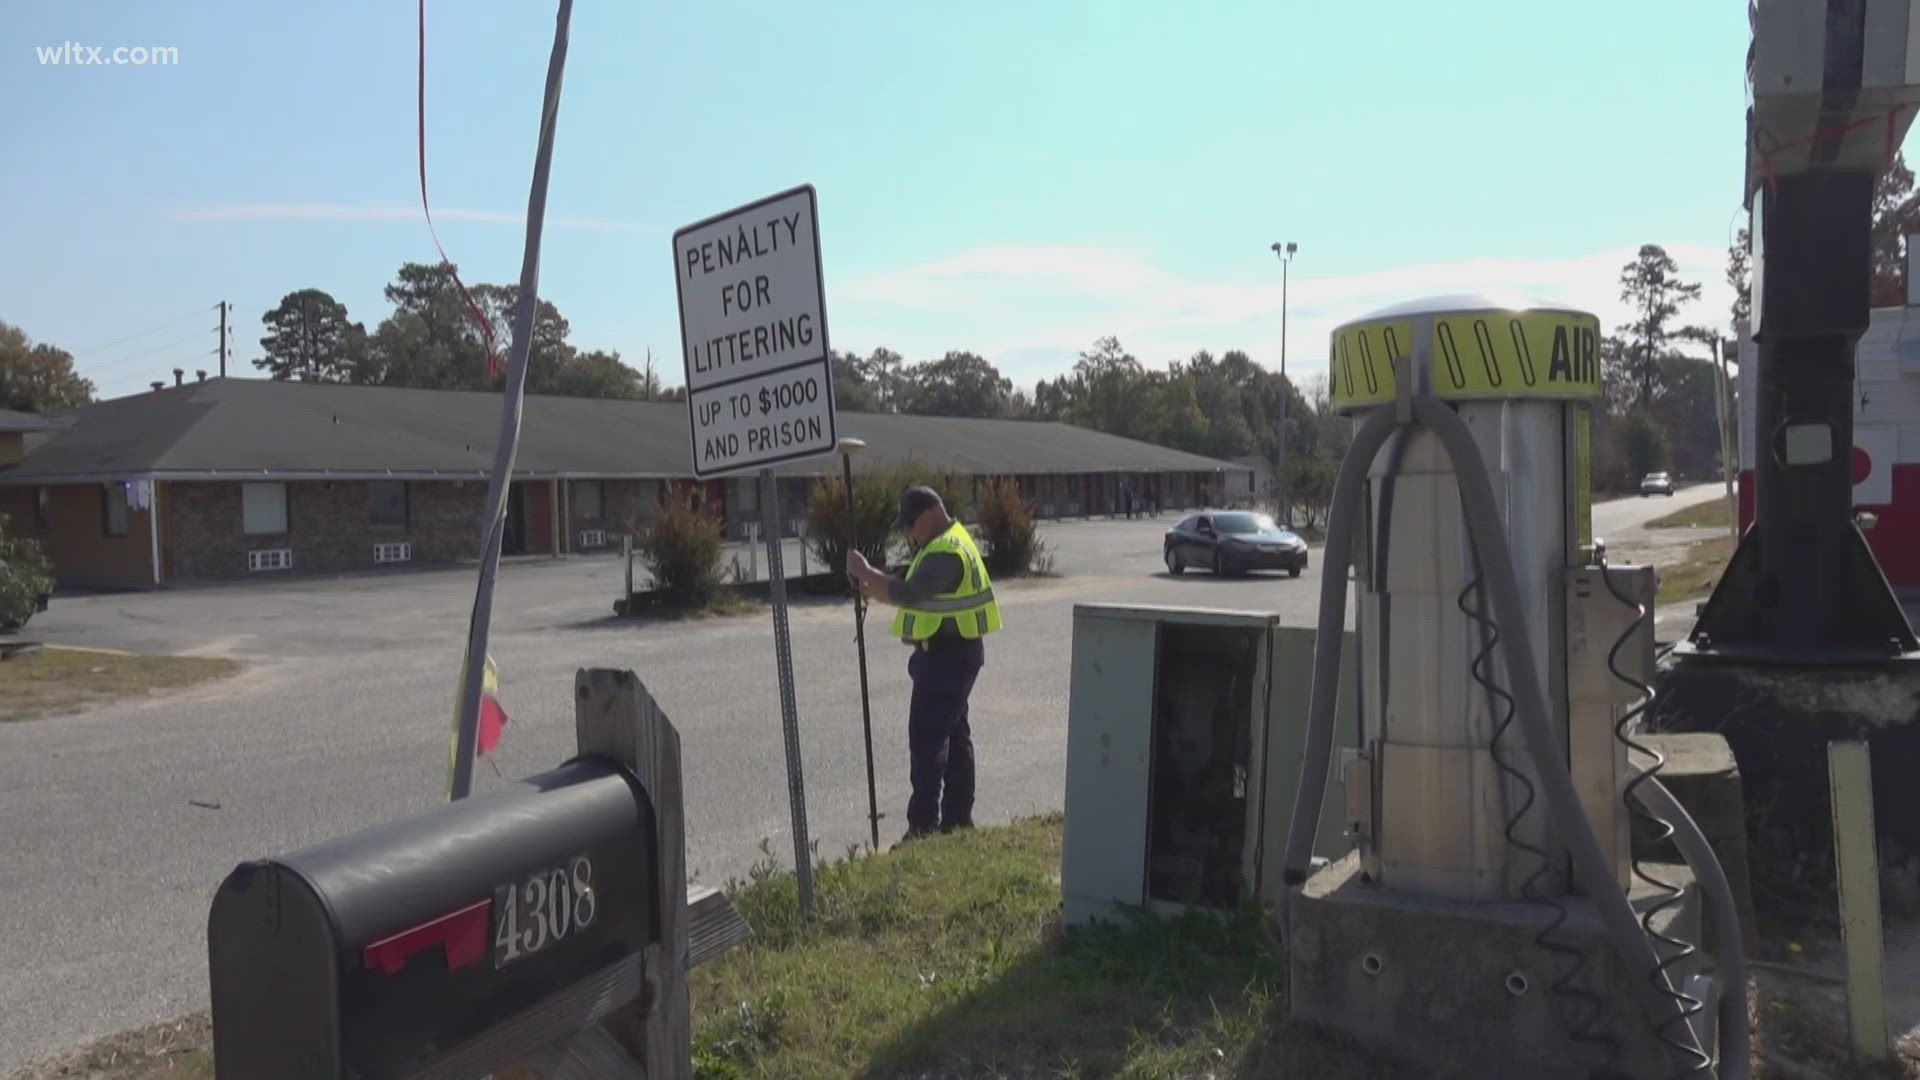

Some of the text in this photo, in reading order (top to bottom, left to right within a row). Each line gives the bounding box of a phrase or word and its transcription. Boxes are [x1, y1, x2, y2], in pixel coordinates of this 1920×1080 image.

[687, 212, 800, 279] PENALTY
[722, 275, 771, 316] FOR
[694, 313, 813, 373] LITTERING
[1549, 325, 1595, 384] AIR
[700, 377, 818, 426] UP TO $1000
[704, 415, 822, 461] AND PRISON
[495, 856, 595, 961] 4308
